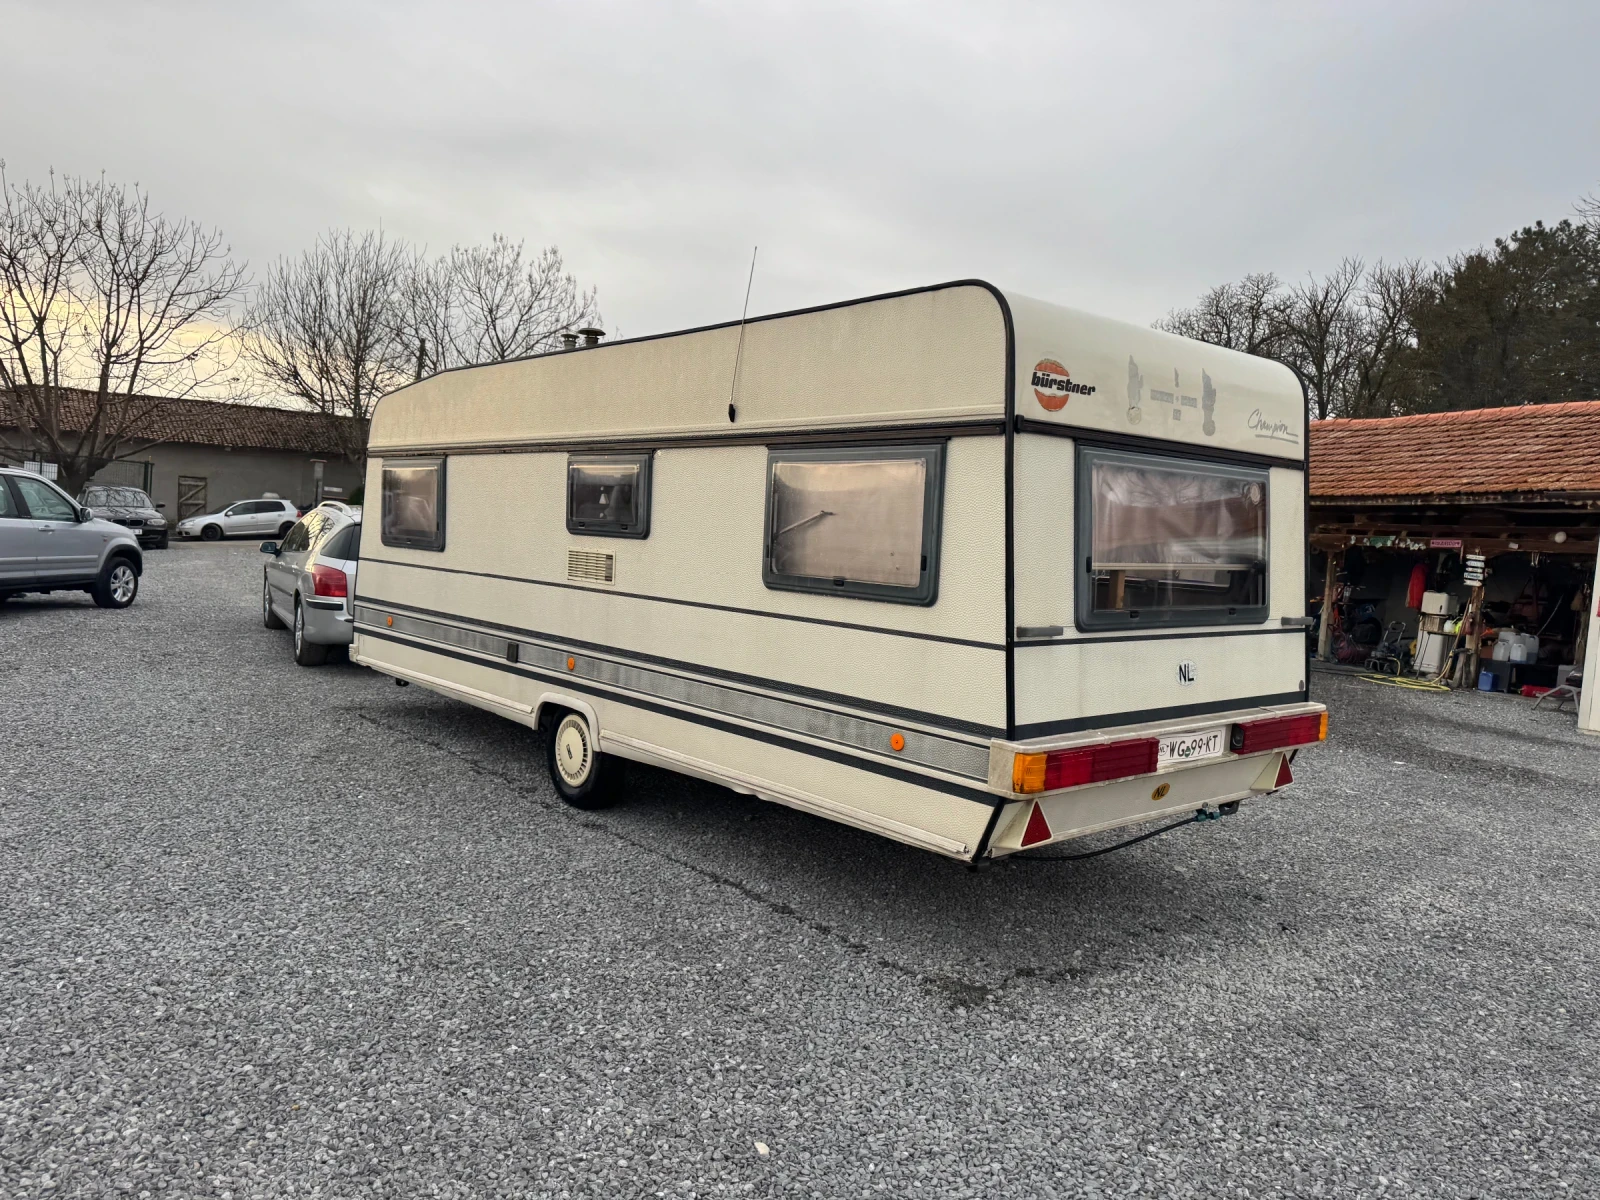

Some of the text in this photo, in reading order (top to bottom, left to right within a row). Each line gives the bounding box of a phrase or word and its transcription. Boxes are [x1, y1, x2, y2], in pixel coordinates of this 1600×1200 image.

[1031, 371, 1096, 396] bürstner
[1247, 408, 1299, 438] Champion
[1179, 663, 1195, 682] NL
[1153, 785, 1167, 799] NL
